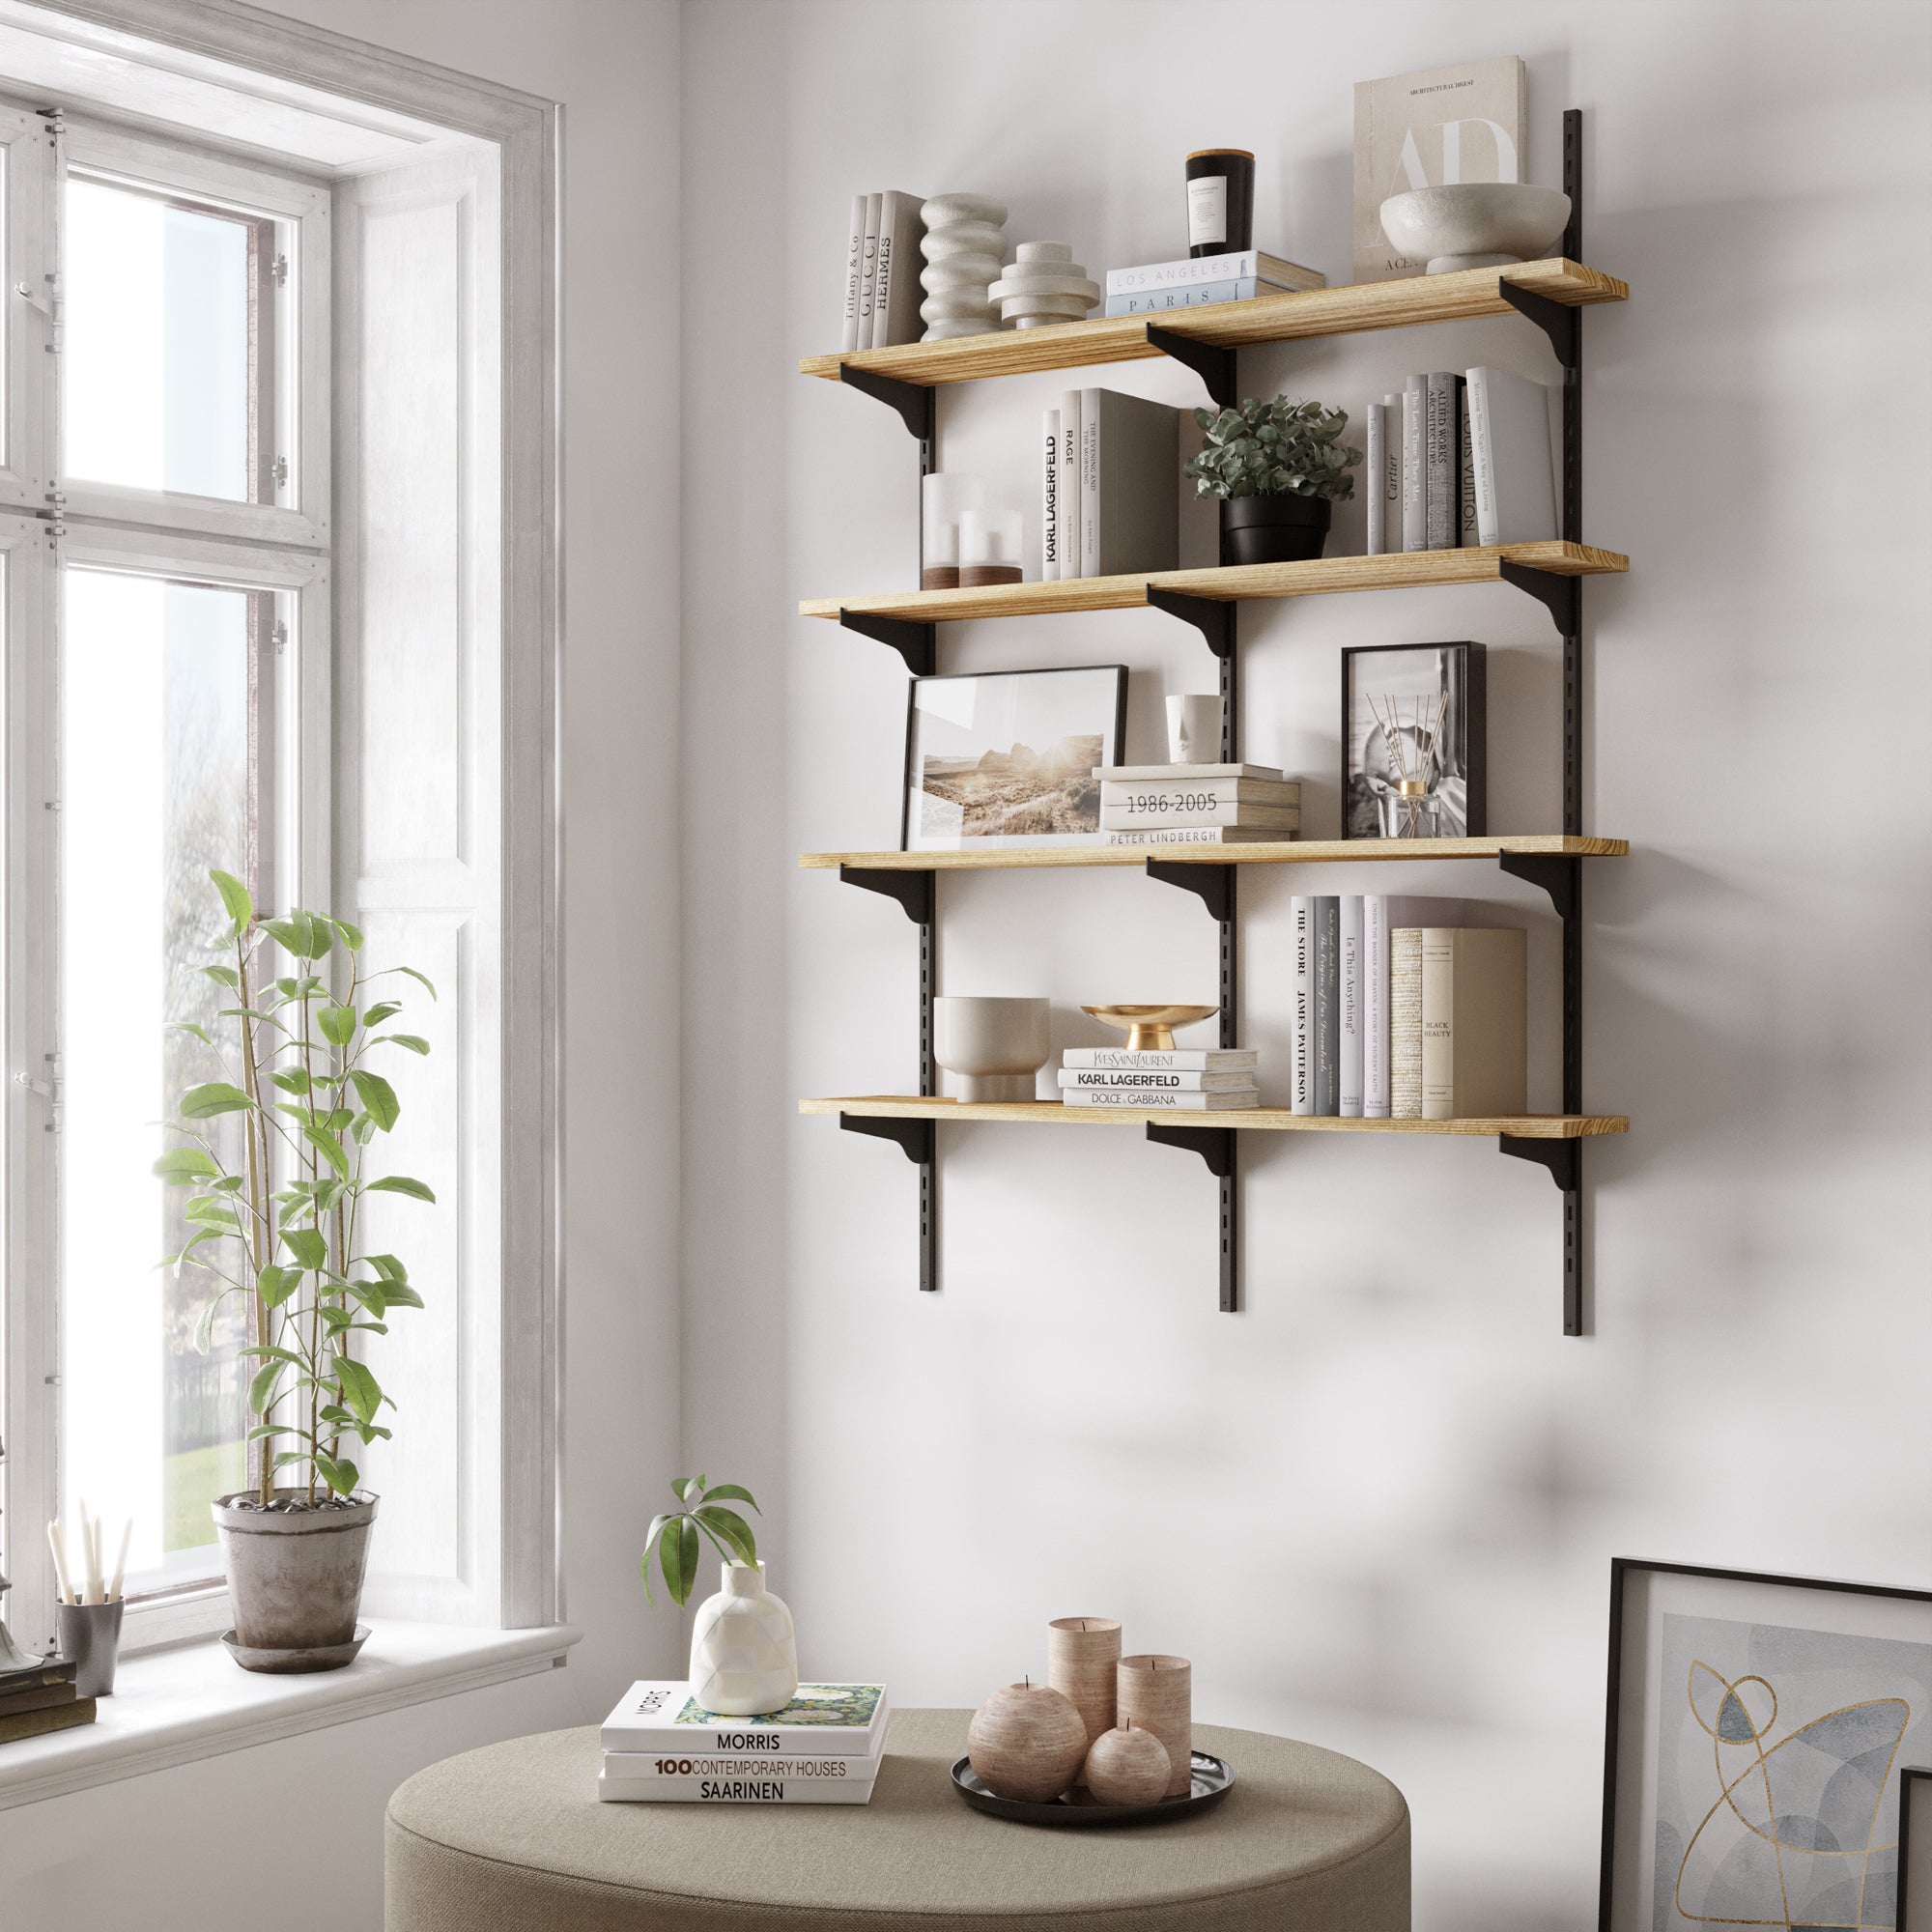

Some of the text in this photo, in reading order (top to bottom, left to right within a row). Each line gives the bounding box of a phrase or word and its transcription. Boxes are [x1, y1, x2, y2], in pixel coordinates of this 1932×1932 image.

[1409, 84, 1454, 97] ARCHITECTURAL
[1364, 118, 1519, 248] AD
[845, 236, 860, 321] Tiffany & Co
[861, 236, 876, 317] GUCCI
[876, 237, 892, 310] HERMES
[1117, 261, 1231, 287] LOS ANGELES
[1128, 290, 1209, 312] PARIS
[1473, 383, 1482, 414] Morning
[1410, 389, 1420, 502] The Last Time They Met
[1437, 389, 1447, 464] ALLIED WORKS
[1065, 430, 1074, 466] RAGE
[1387, 454, 1398, 500] Cartier
[1463, 463, 1476, 531] VUITTON
[1046, 436, 1056, 562] KARL LAGERFELD
[1127, 793, 1217, 813] 1986-2005
[1110, 831, 1217, 844] PETER LINDBERGH
[1297, 908, 1306, 977] THE STORE
[1318, 933, 1328, 1072] The Origins of Our Discontents
[1345, 937, 1355, 1036] Is This Anything?
[1426, 1021, 1449, 1030] BLACK
[1297, 991, 1307, 1104] JAMES PATTERSON
[1078, 1074, 1179, 1087] KARL LAGERFELD
[1092, 1094, 1122, 1104] DOLCE
[1127, 1094, 1177, 1105] GABBANA
[717, 1734, 780, 1749] MORRIS
[796, 1761, 846, 1776] HOUSES
[700, 1781, 783, 1800] SAARINEN
